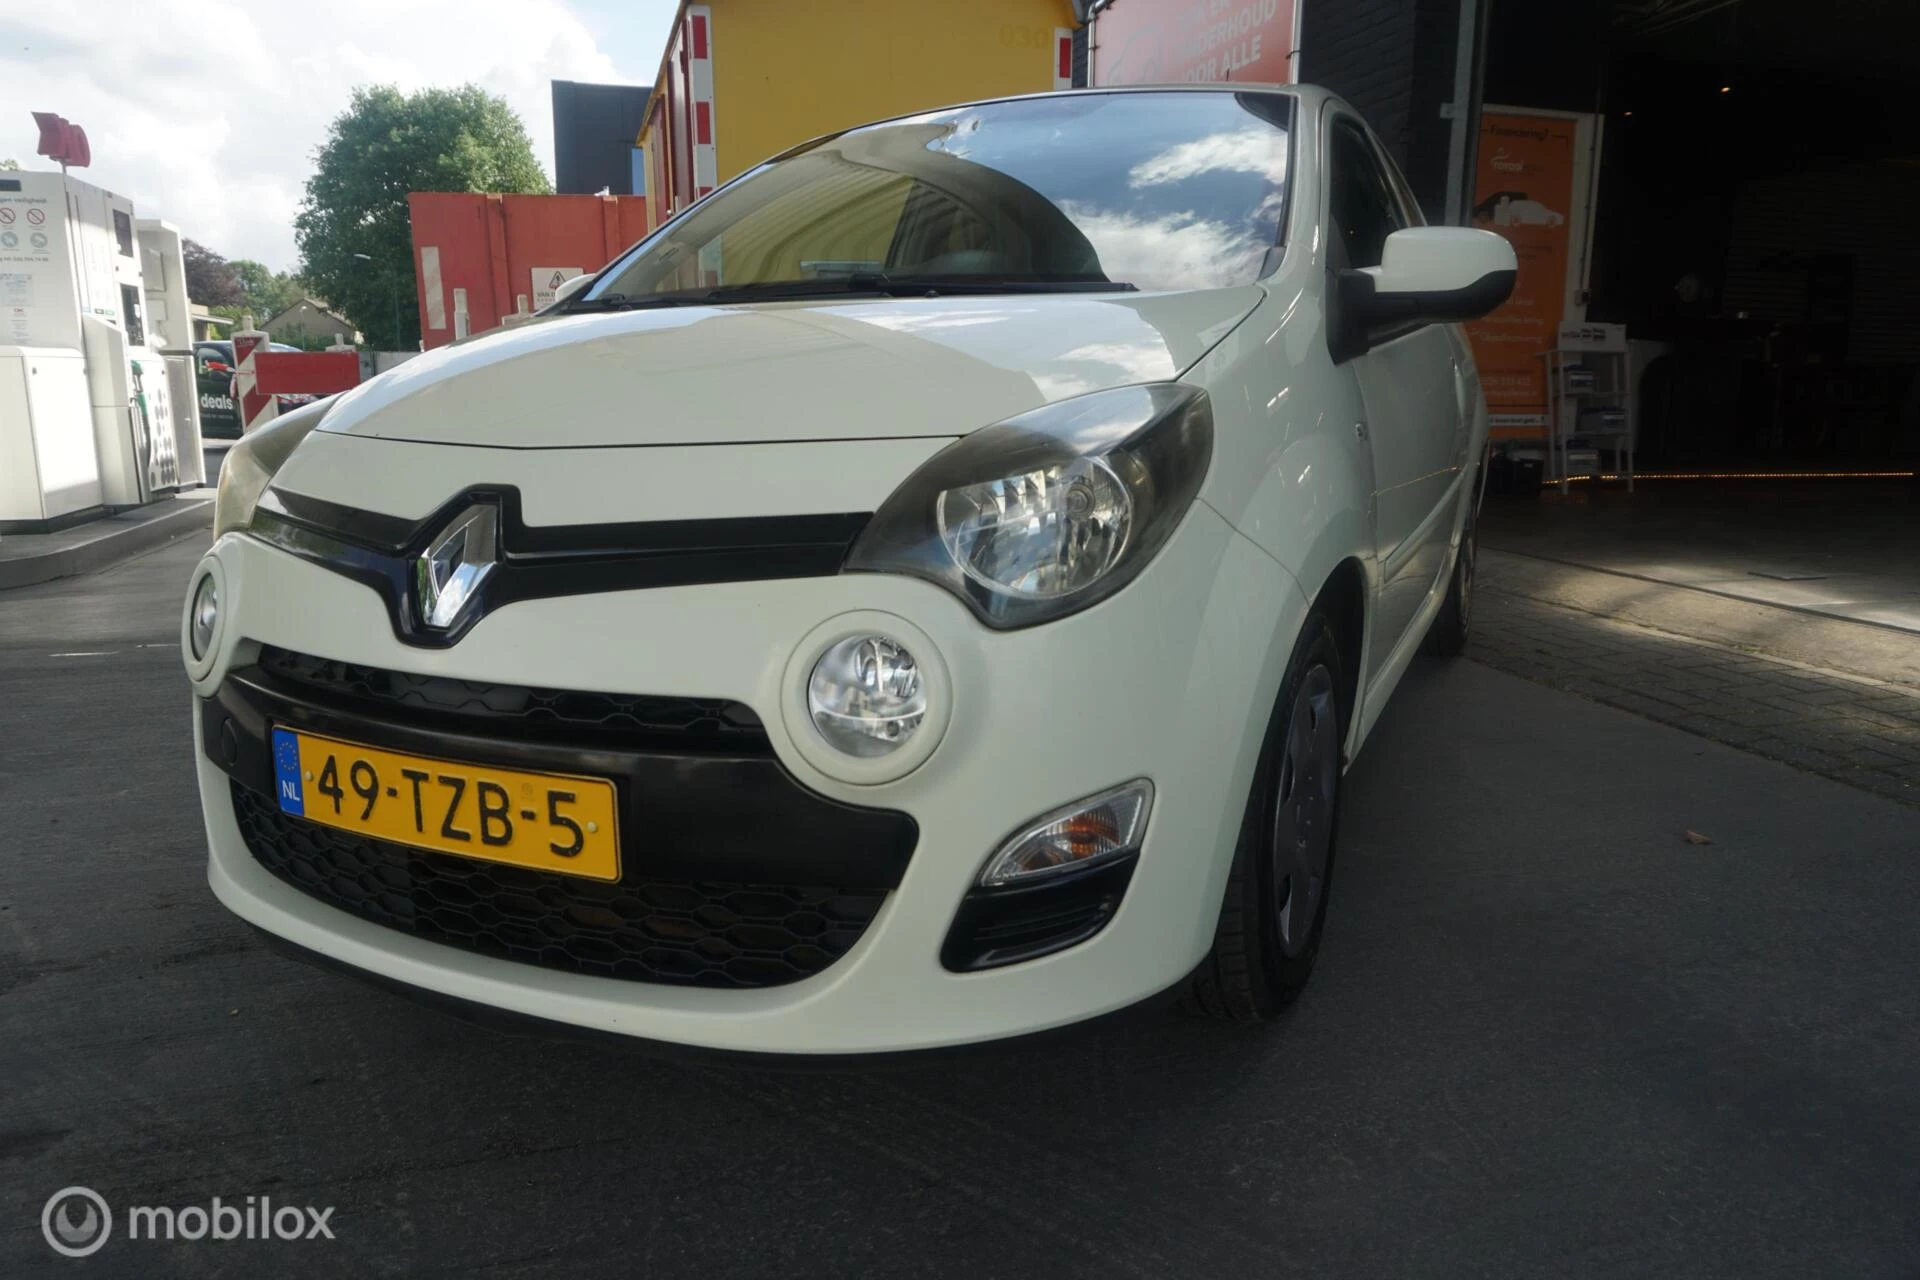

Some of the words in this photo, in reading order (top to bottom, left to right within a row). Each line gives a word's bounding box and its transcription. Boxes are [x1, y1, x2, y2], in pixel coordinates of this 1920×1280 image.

[1178, 0, 1277, 58] DERHOUD
[1185, 56, 1217, 82] OOR
[1219, 34, 1262, 79] ALLE
[200, 393, 234, 410] deals
[282, 779, 300, 801] NL
[317, 754, 585, 858] 49-TZB-5
